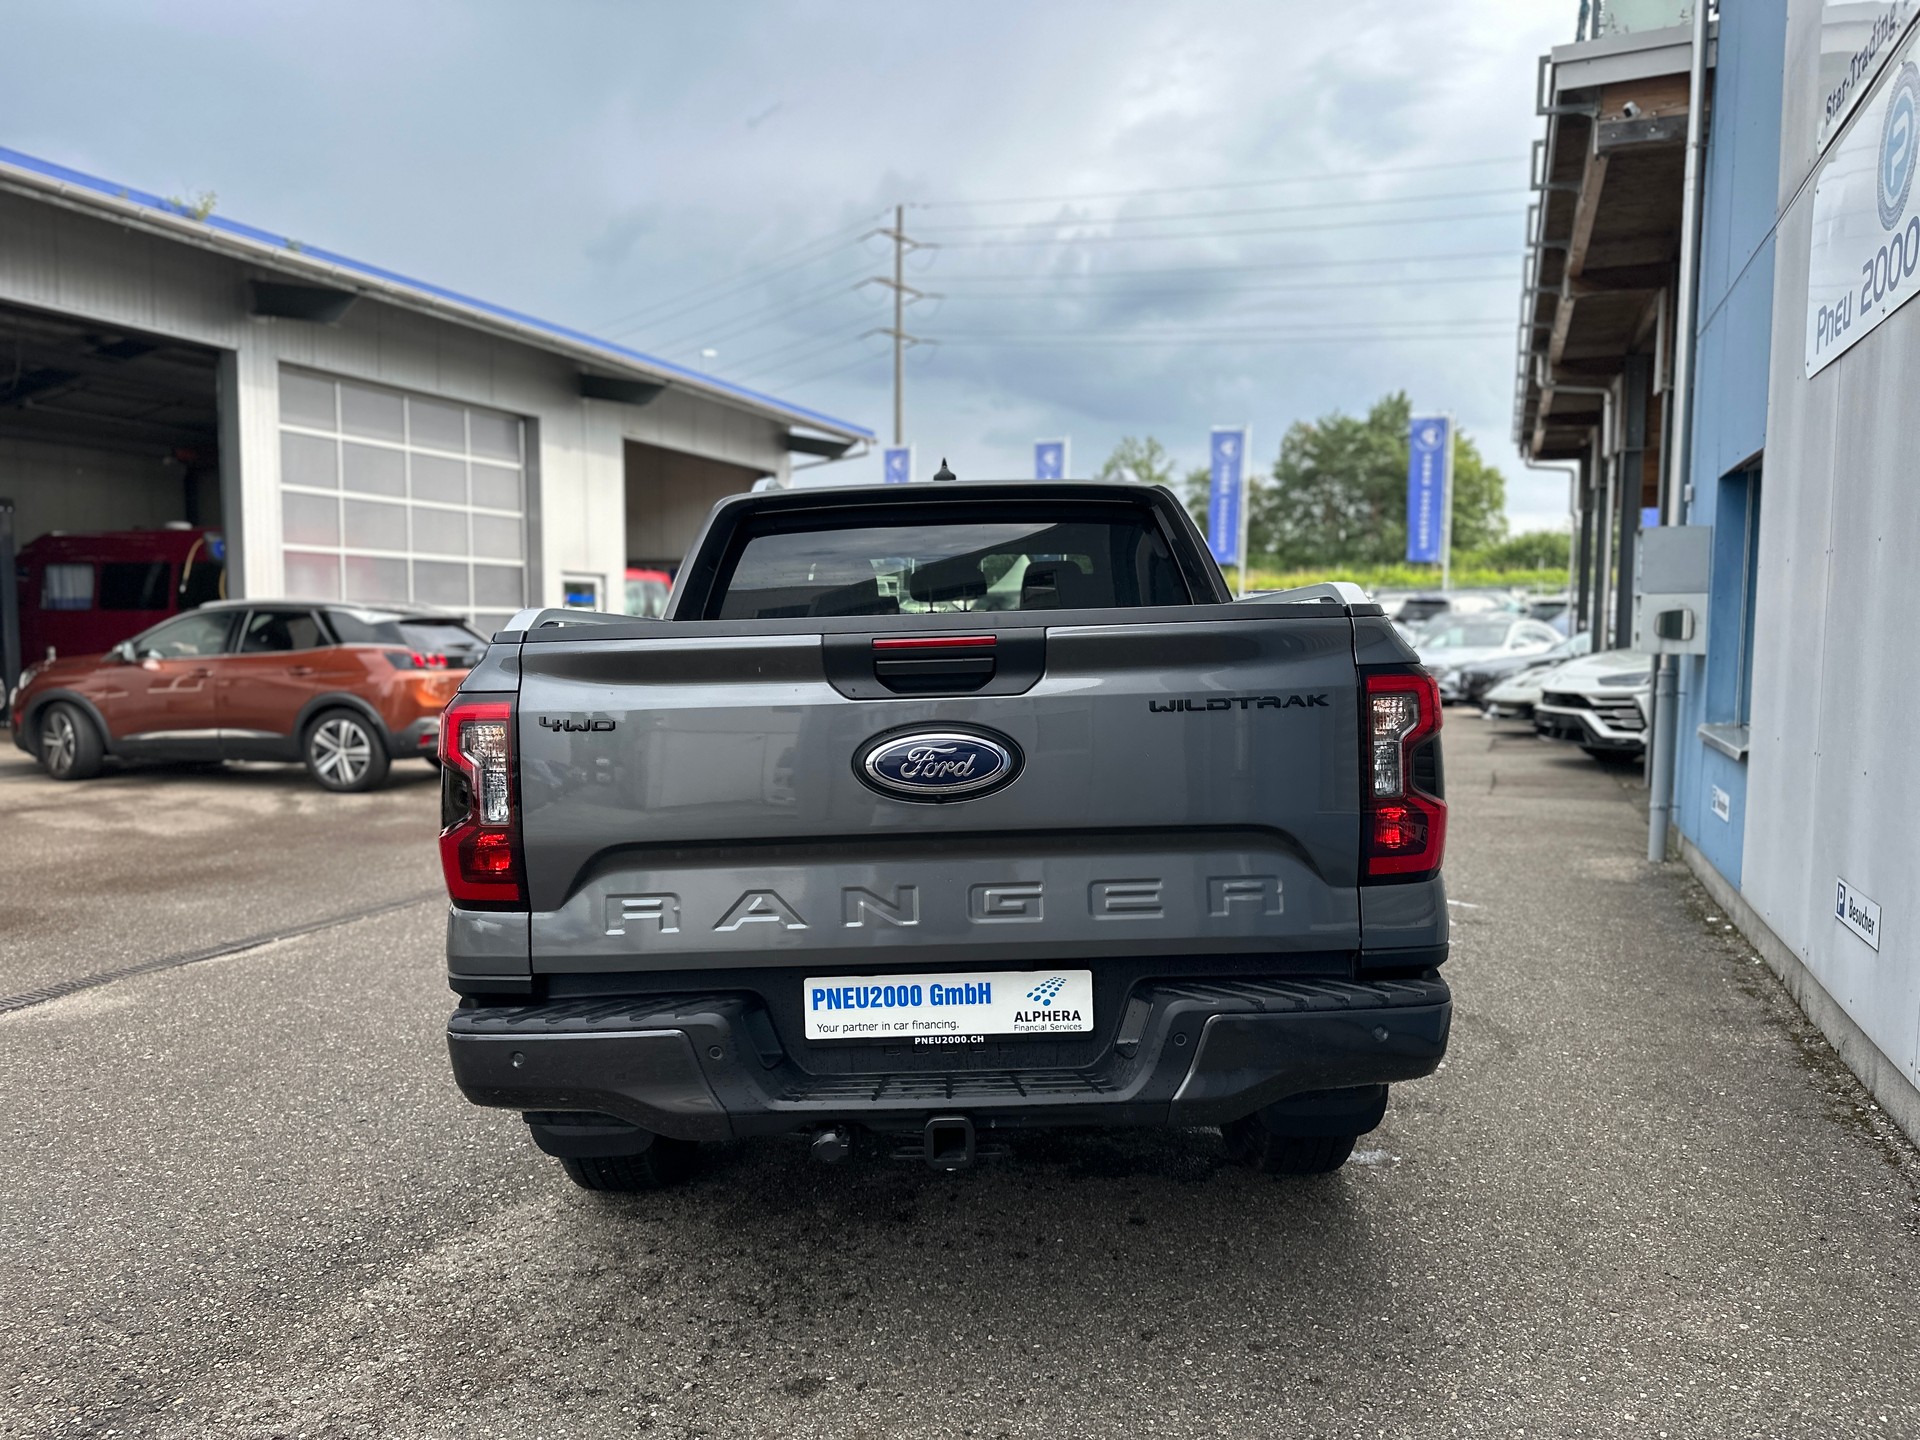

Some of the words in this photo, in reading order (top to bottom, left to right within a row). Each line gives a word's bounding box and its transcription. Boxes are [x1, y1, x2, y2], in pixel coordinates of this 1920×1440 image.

[1816, 290, 1853, 355] Pneu
[1860, 215, 1920, 317] 2000
[1149, 694, 1329, 713] WILDTRAK
[538, 716, 616, 732] 4WD
[900, 747, 976, 779] Ford
[604, 874, 1284, 935] RANGER
[1848, 896, 1874, 935] Besucher
[811, 985, 923, 1011] PNEU2000
[929, 982, 992, 1007] GmbH
[1014, 1010, 1082, 1022] ALPHERA
[816, 1023, 839, 1033] Your
[842, 1021, 878, 1034] partner
[881, 1021, 891, 1031] in
[893, 1021, 909, 1031] car
[912, 1019, 960, 1031] financing.
[1014, 1023, 1047, 1032] Financial
[1050, 1023, 1082, 1031] Services
[914, 1035, 985, 1045] PNEU2000.CH
